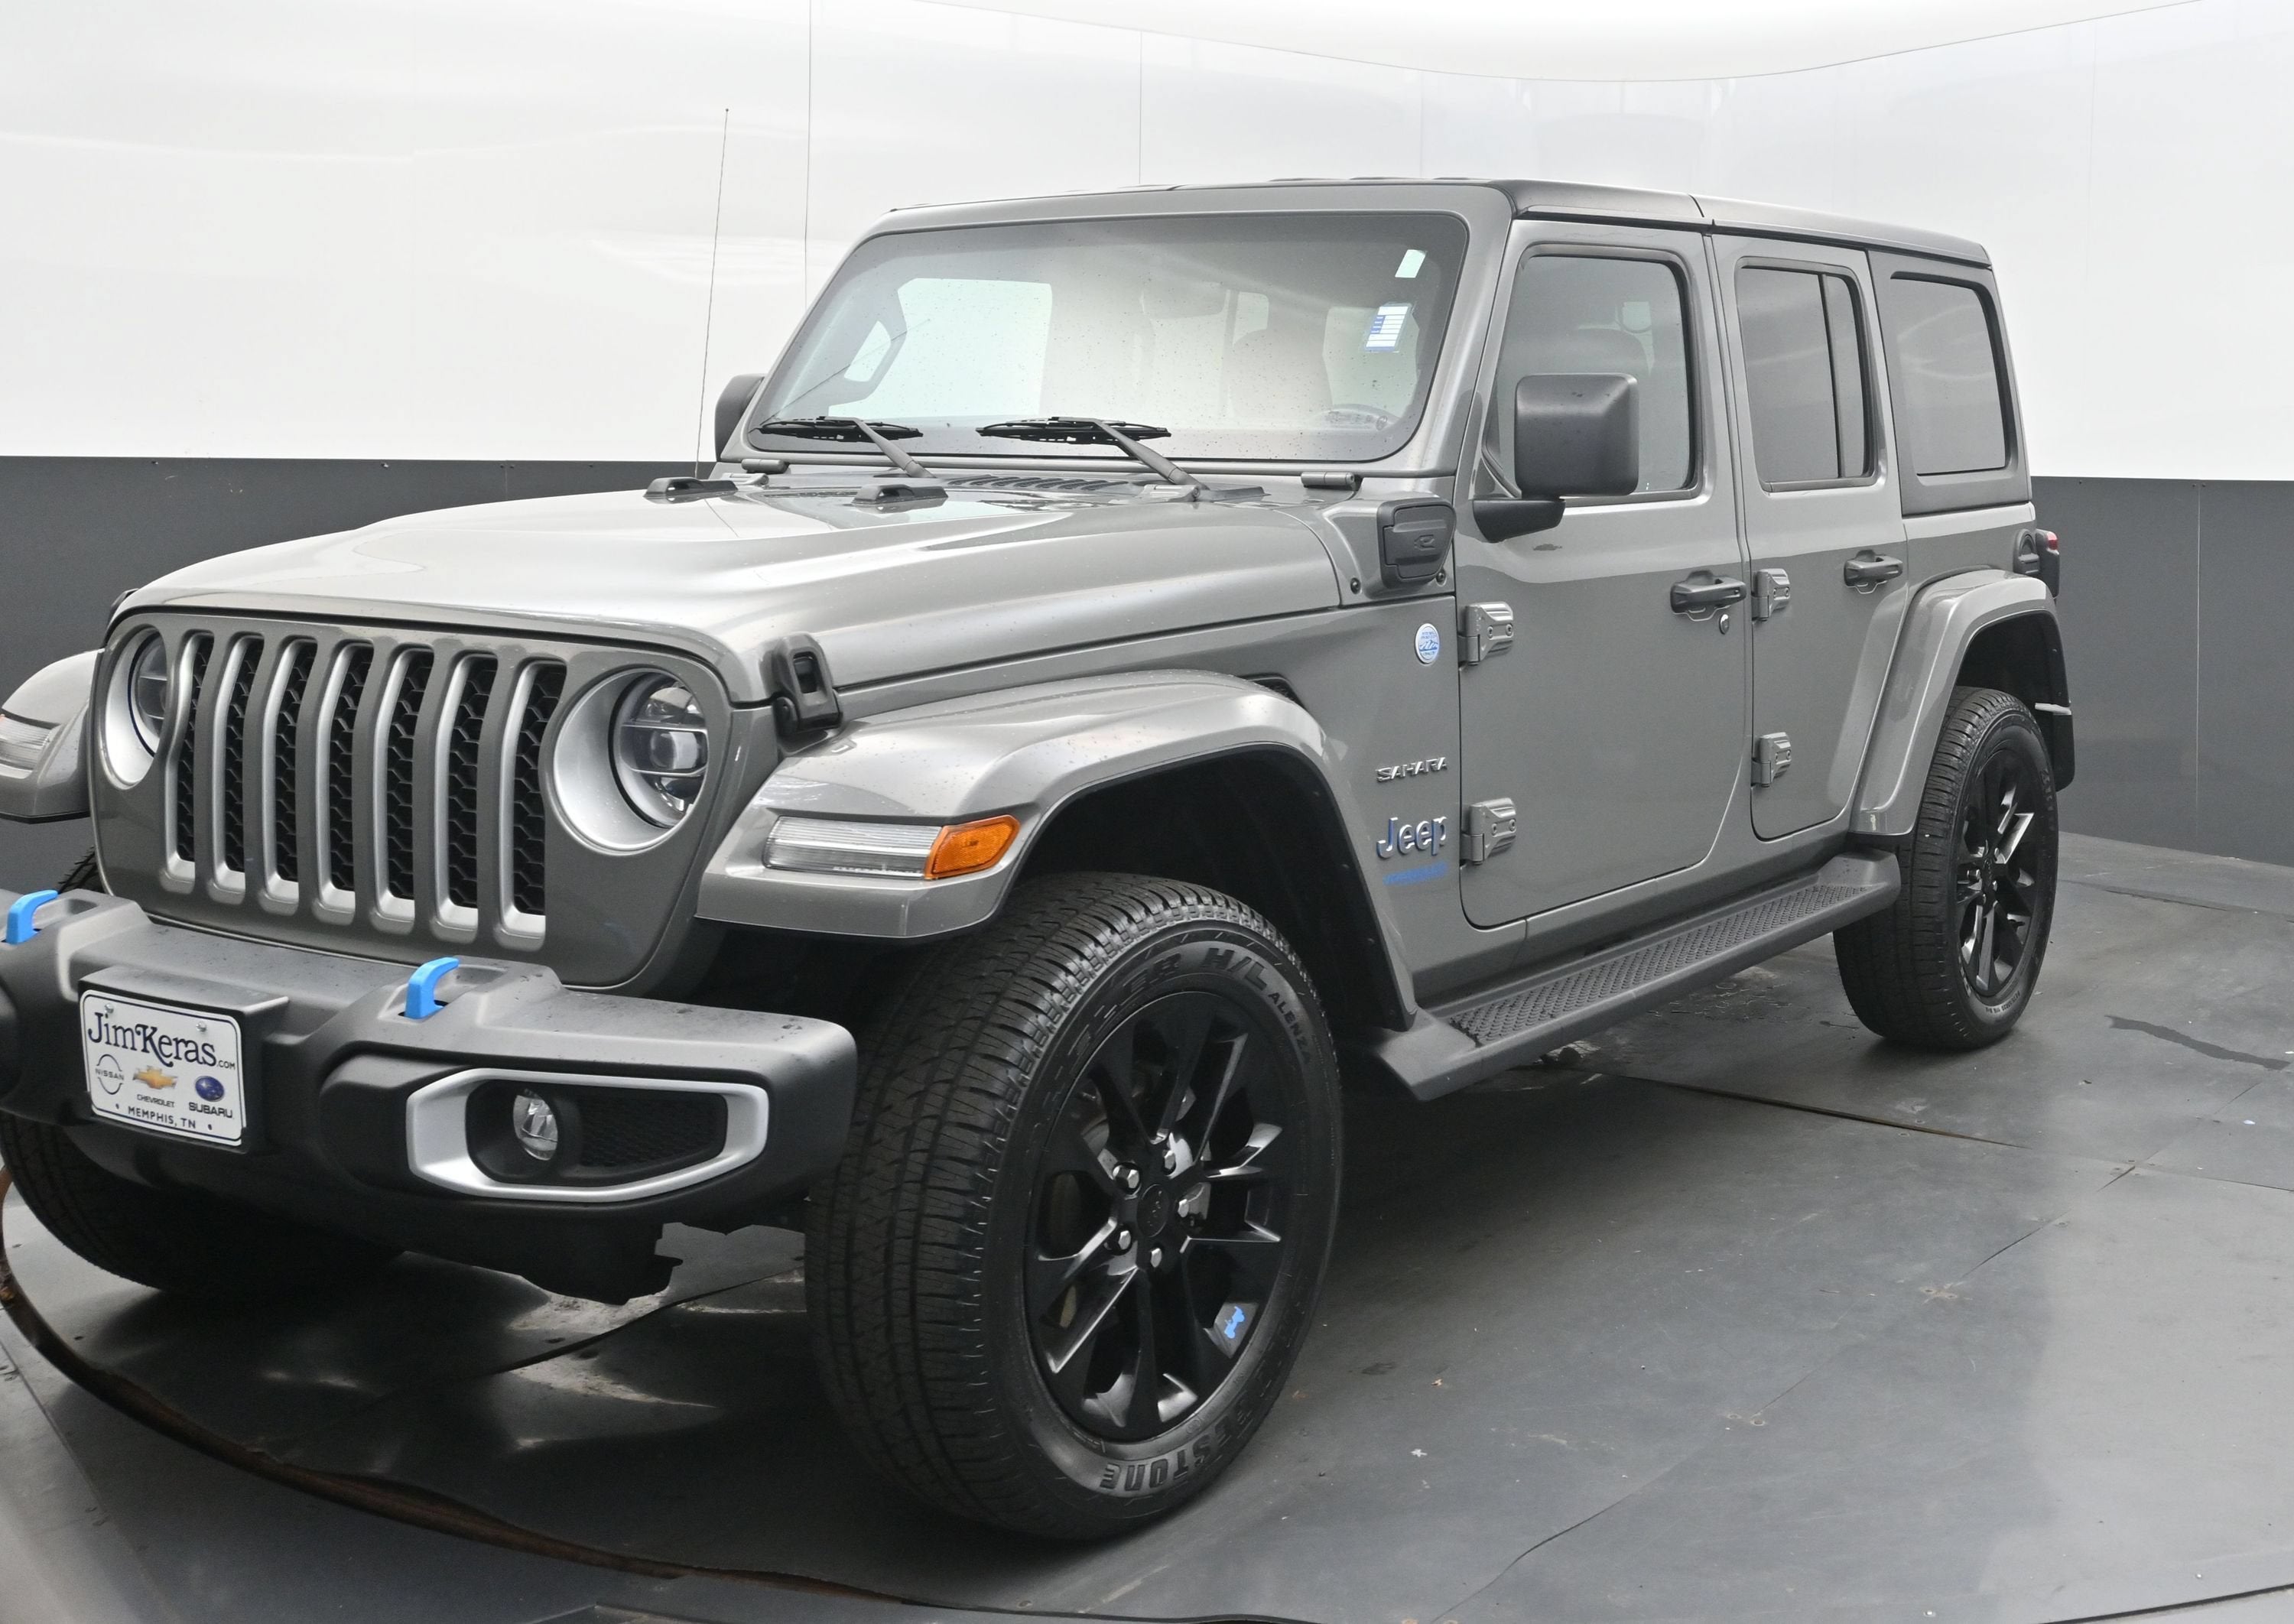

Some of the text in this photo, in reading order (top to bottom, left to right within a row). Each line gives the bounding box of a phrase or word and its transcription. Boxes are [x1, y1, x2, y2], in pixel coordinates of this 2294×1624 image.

[1375, 757, 1448, 781] SAHARA
[1376, 816, 1448, 858] Jeep
[96, 1068, 124, 1080] NISSAN
[136, 1093, 176, 1107] CHEVROLET
[188, 1102, 233, 1119] SUBARU
[180, 1117, 197, 1129] TN
